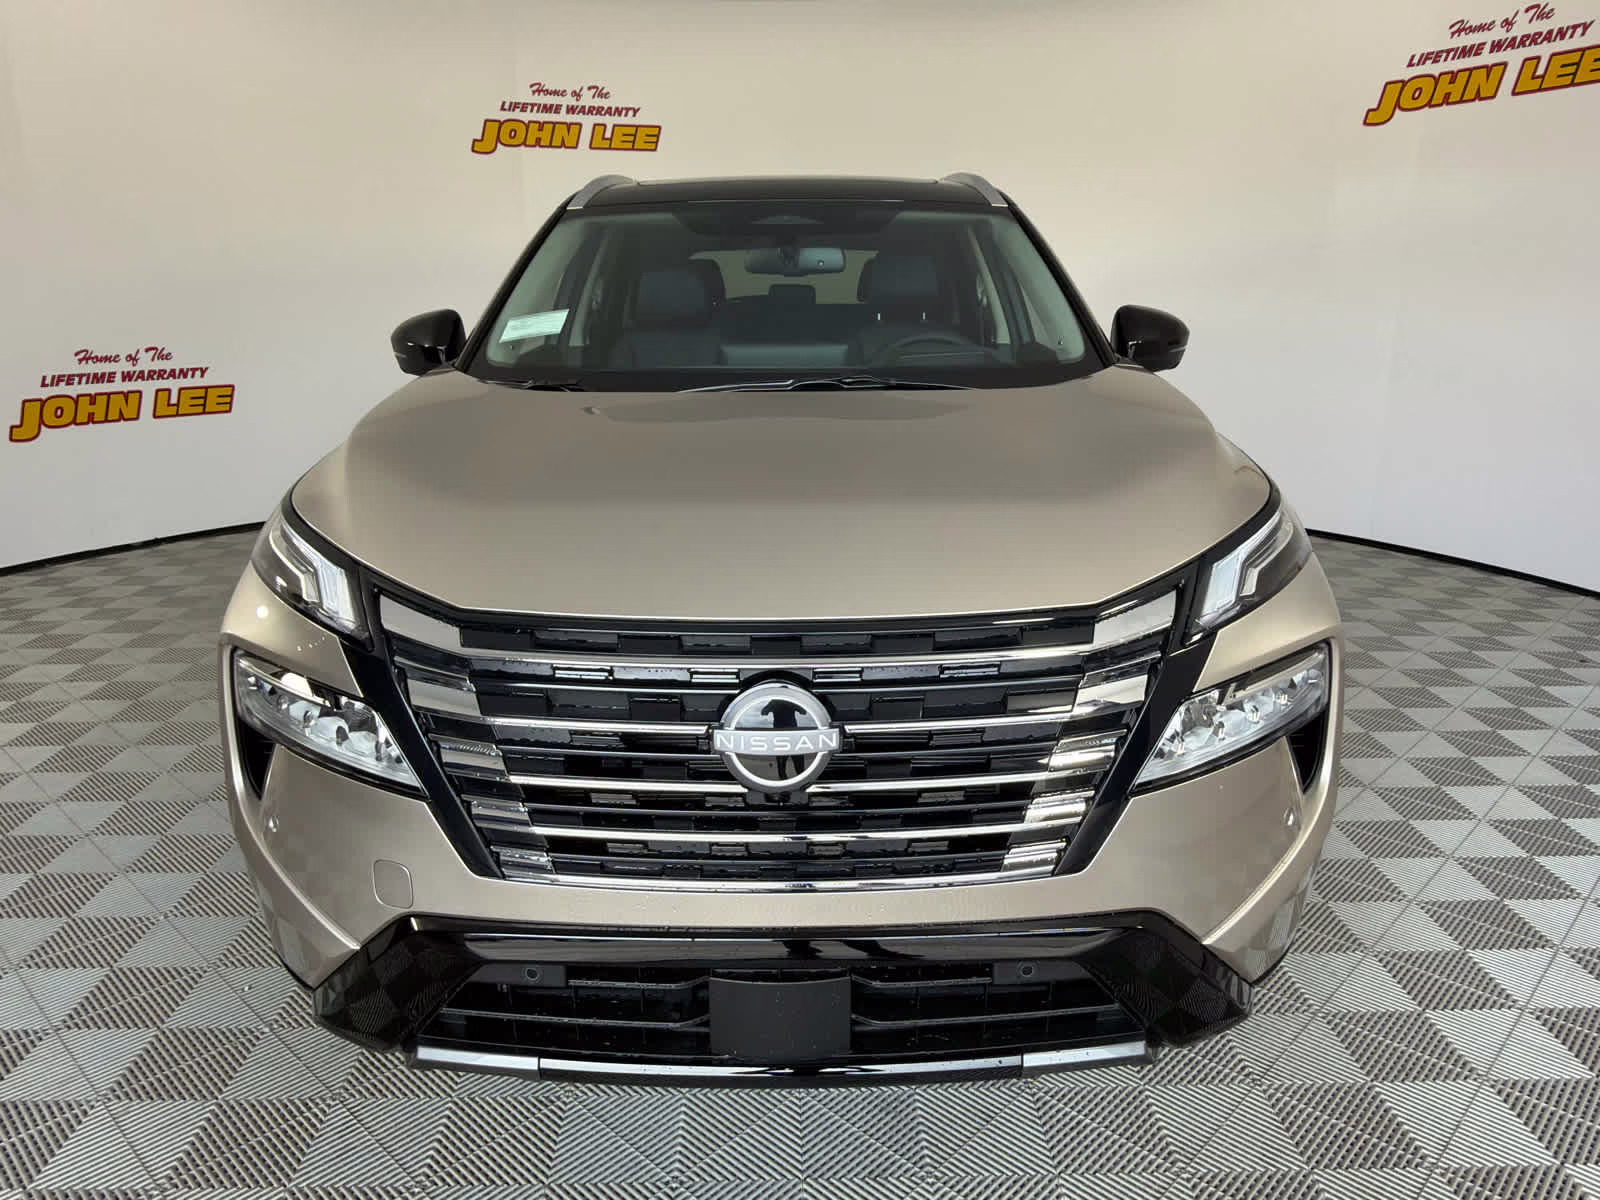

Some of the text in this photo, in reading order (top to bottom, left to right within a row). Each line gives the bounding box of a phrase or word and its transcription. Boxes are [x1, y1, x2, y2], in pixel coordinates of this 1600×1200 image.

[1449, 2, 1556, 39] Home of The
[1406, 20, 1595, 68] LIFETIME WARRANTY
[530, 82, 610, 101] Home of The
[1363, 44, 1600, 126] JOHN LEE
[500, 100, 640, 117] LIFETIME WARRANTY
[472, 119, 661, 154] JOHN LEE
[74, 347, 173, 368] Home of The
[40, 367, 209, 388] LIFETIME WARRANTY
[9, 384, 235, 442] JOHN LEE
[716, 732, 837, 751] NISSAN
